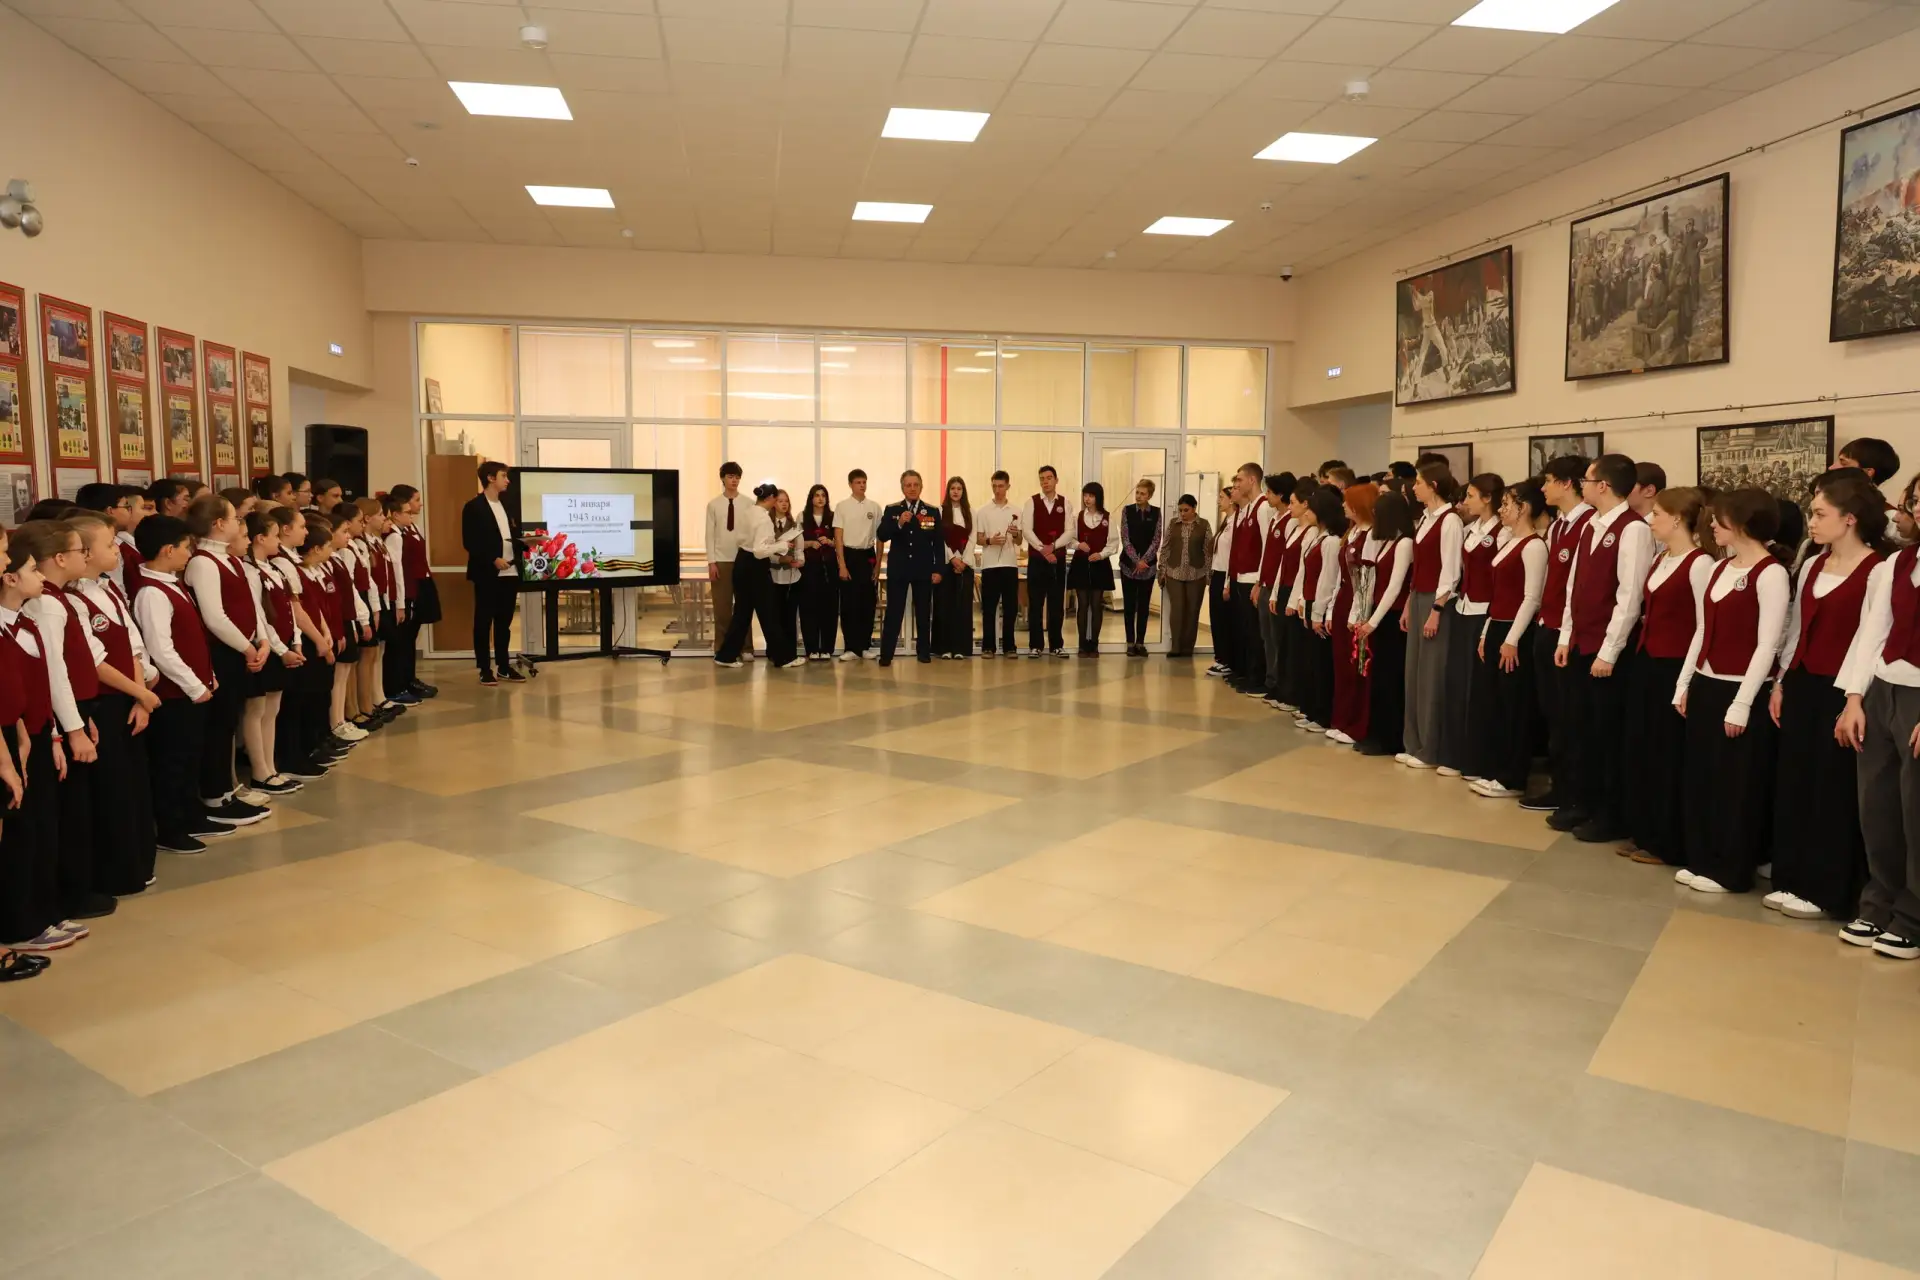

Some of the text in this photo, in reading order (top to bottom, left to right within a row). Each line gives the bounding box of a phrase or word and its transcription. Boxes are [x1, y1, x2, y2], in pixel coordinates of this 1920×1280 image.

[567, 498, 611, 510] 21 января
[568, 513, 589, 522] 1943
